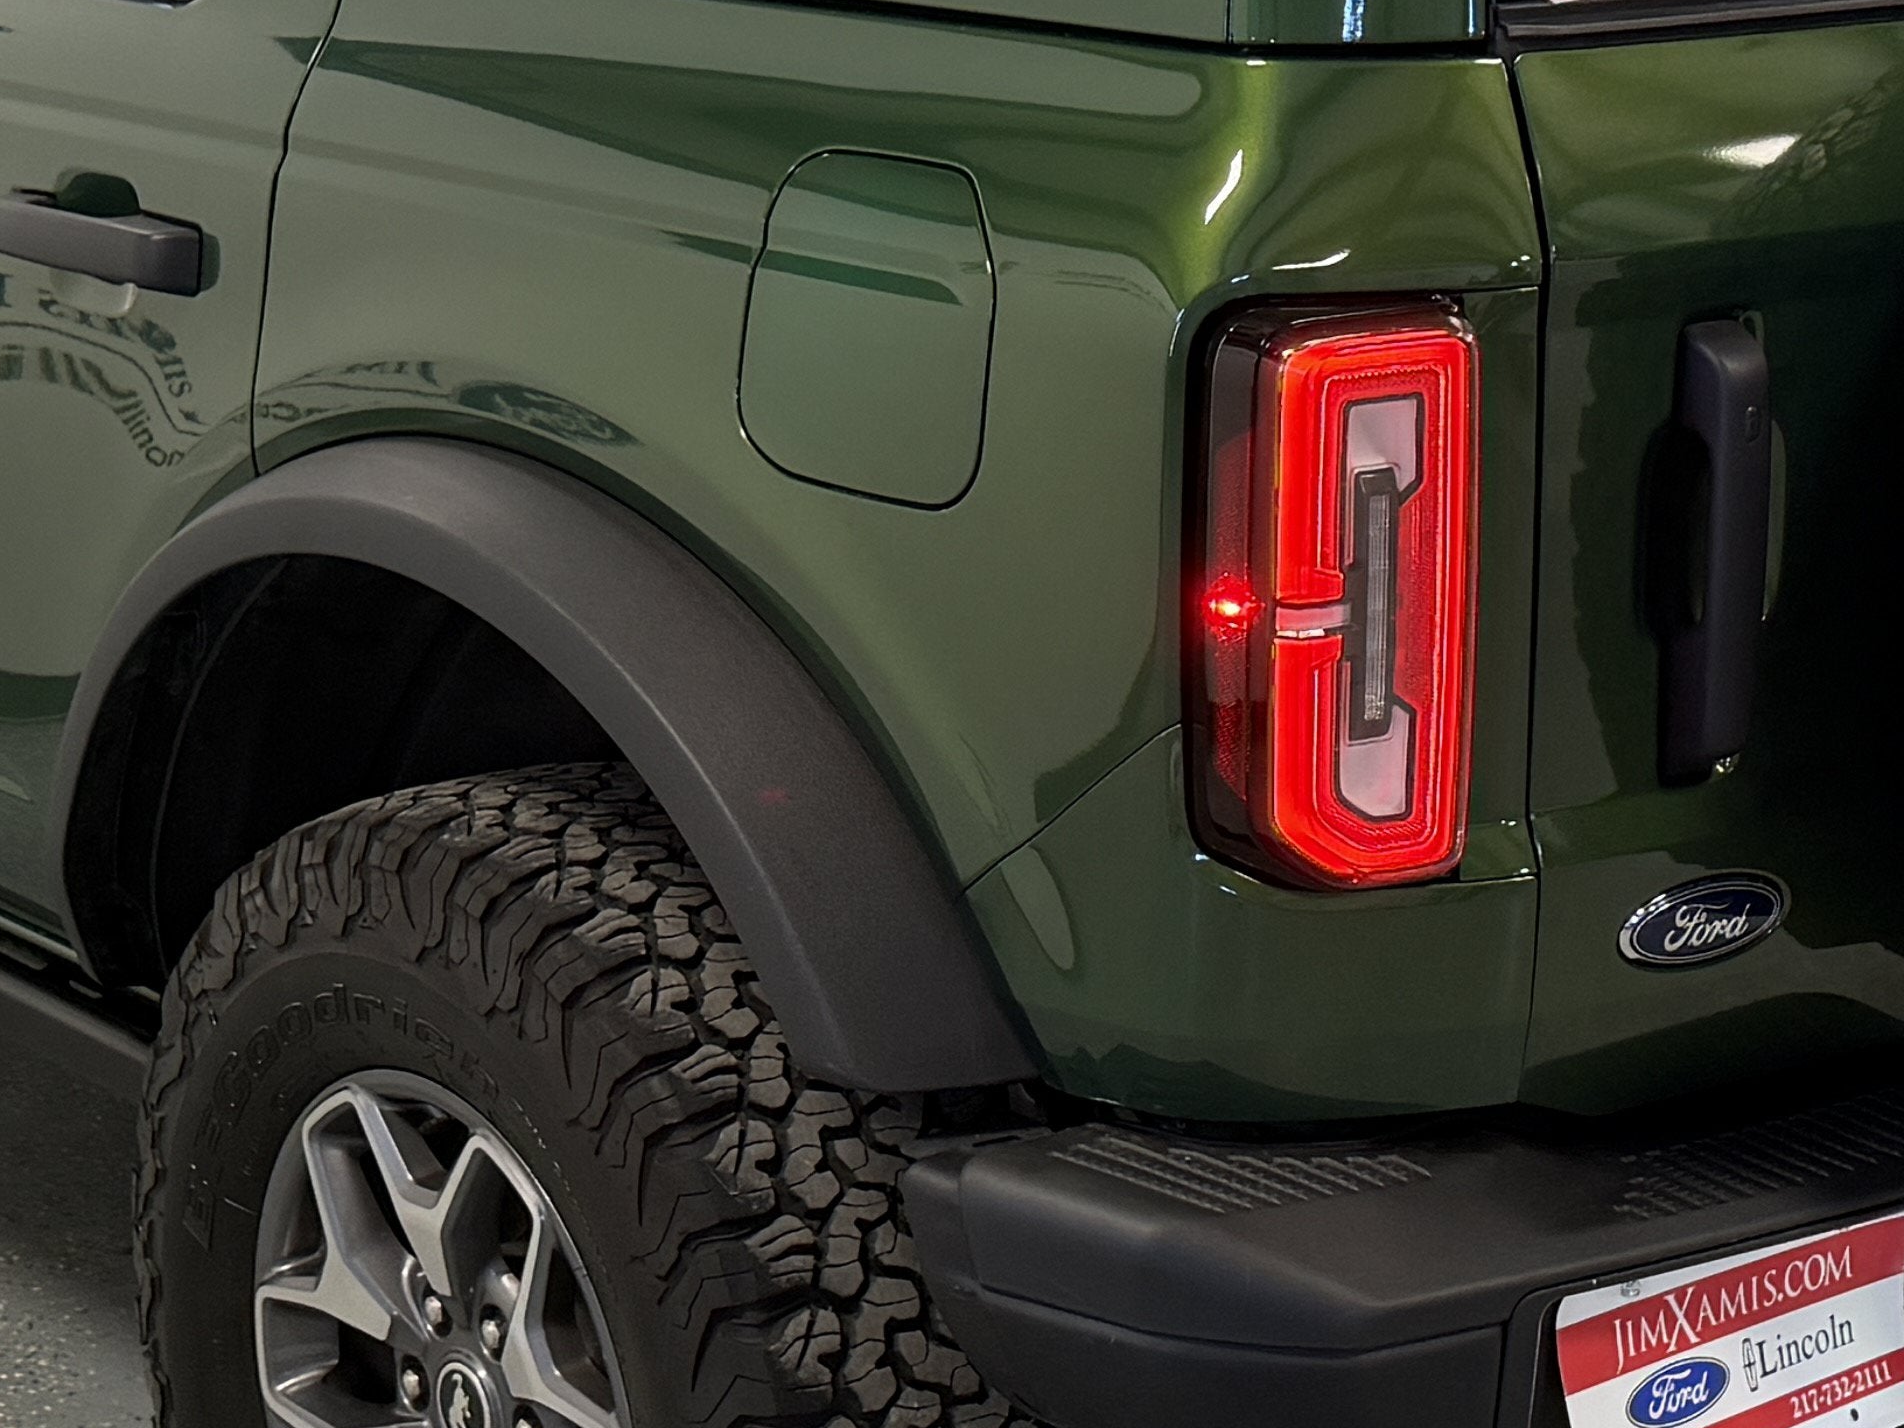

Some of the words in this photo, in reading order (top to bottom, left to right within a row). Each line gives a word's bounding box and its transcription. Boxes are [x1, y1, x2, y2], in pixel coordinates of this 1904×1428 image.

[1663, 902, 1751, 953] Ford
[1755, 1313, 1856, 1380] Lincoln
[1648, 1368, 1710, 1421] Ford
[1790, 1360, 1893, 1419] 217-732-2111
